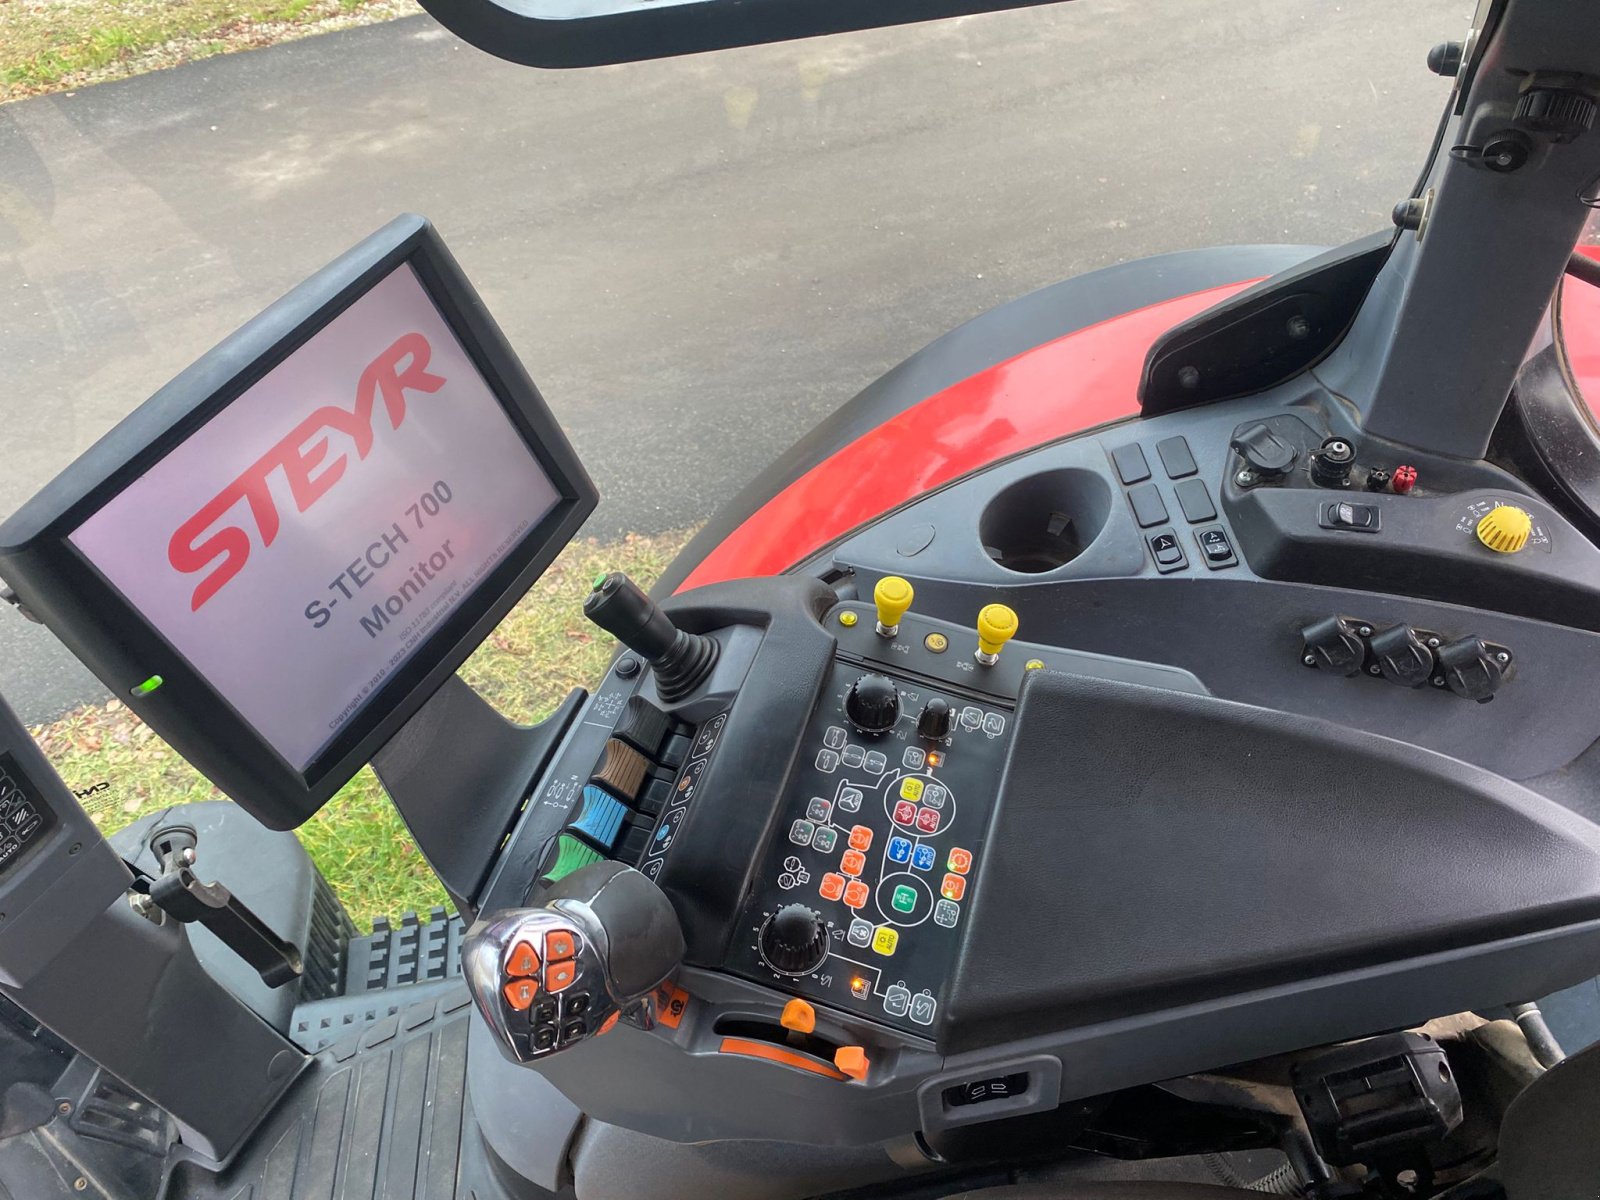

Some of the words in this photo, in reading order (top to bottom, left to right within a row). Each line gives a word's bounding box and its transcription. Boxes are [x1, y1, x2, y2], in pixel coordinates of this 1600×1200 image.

[168, 332, 447, 612] STEYR
[304, 523, 409, 629] S-TECH
[405, 480, 453, 529] 700
[359, 539, 455, 639] Monitor
[328, 693, 364, 731] Copyright
[404, 632, 422, 650] CNH
[419, 601, 452, 634] Industrial
